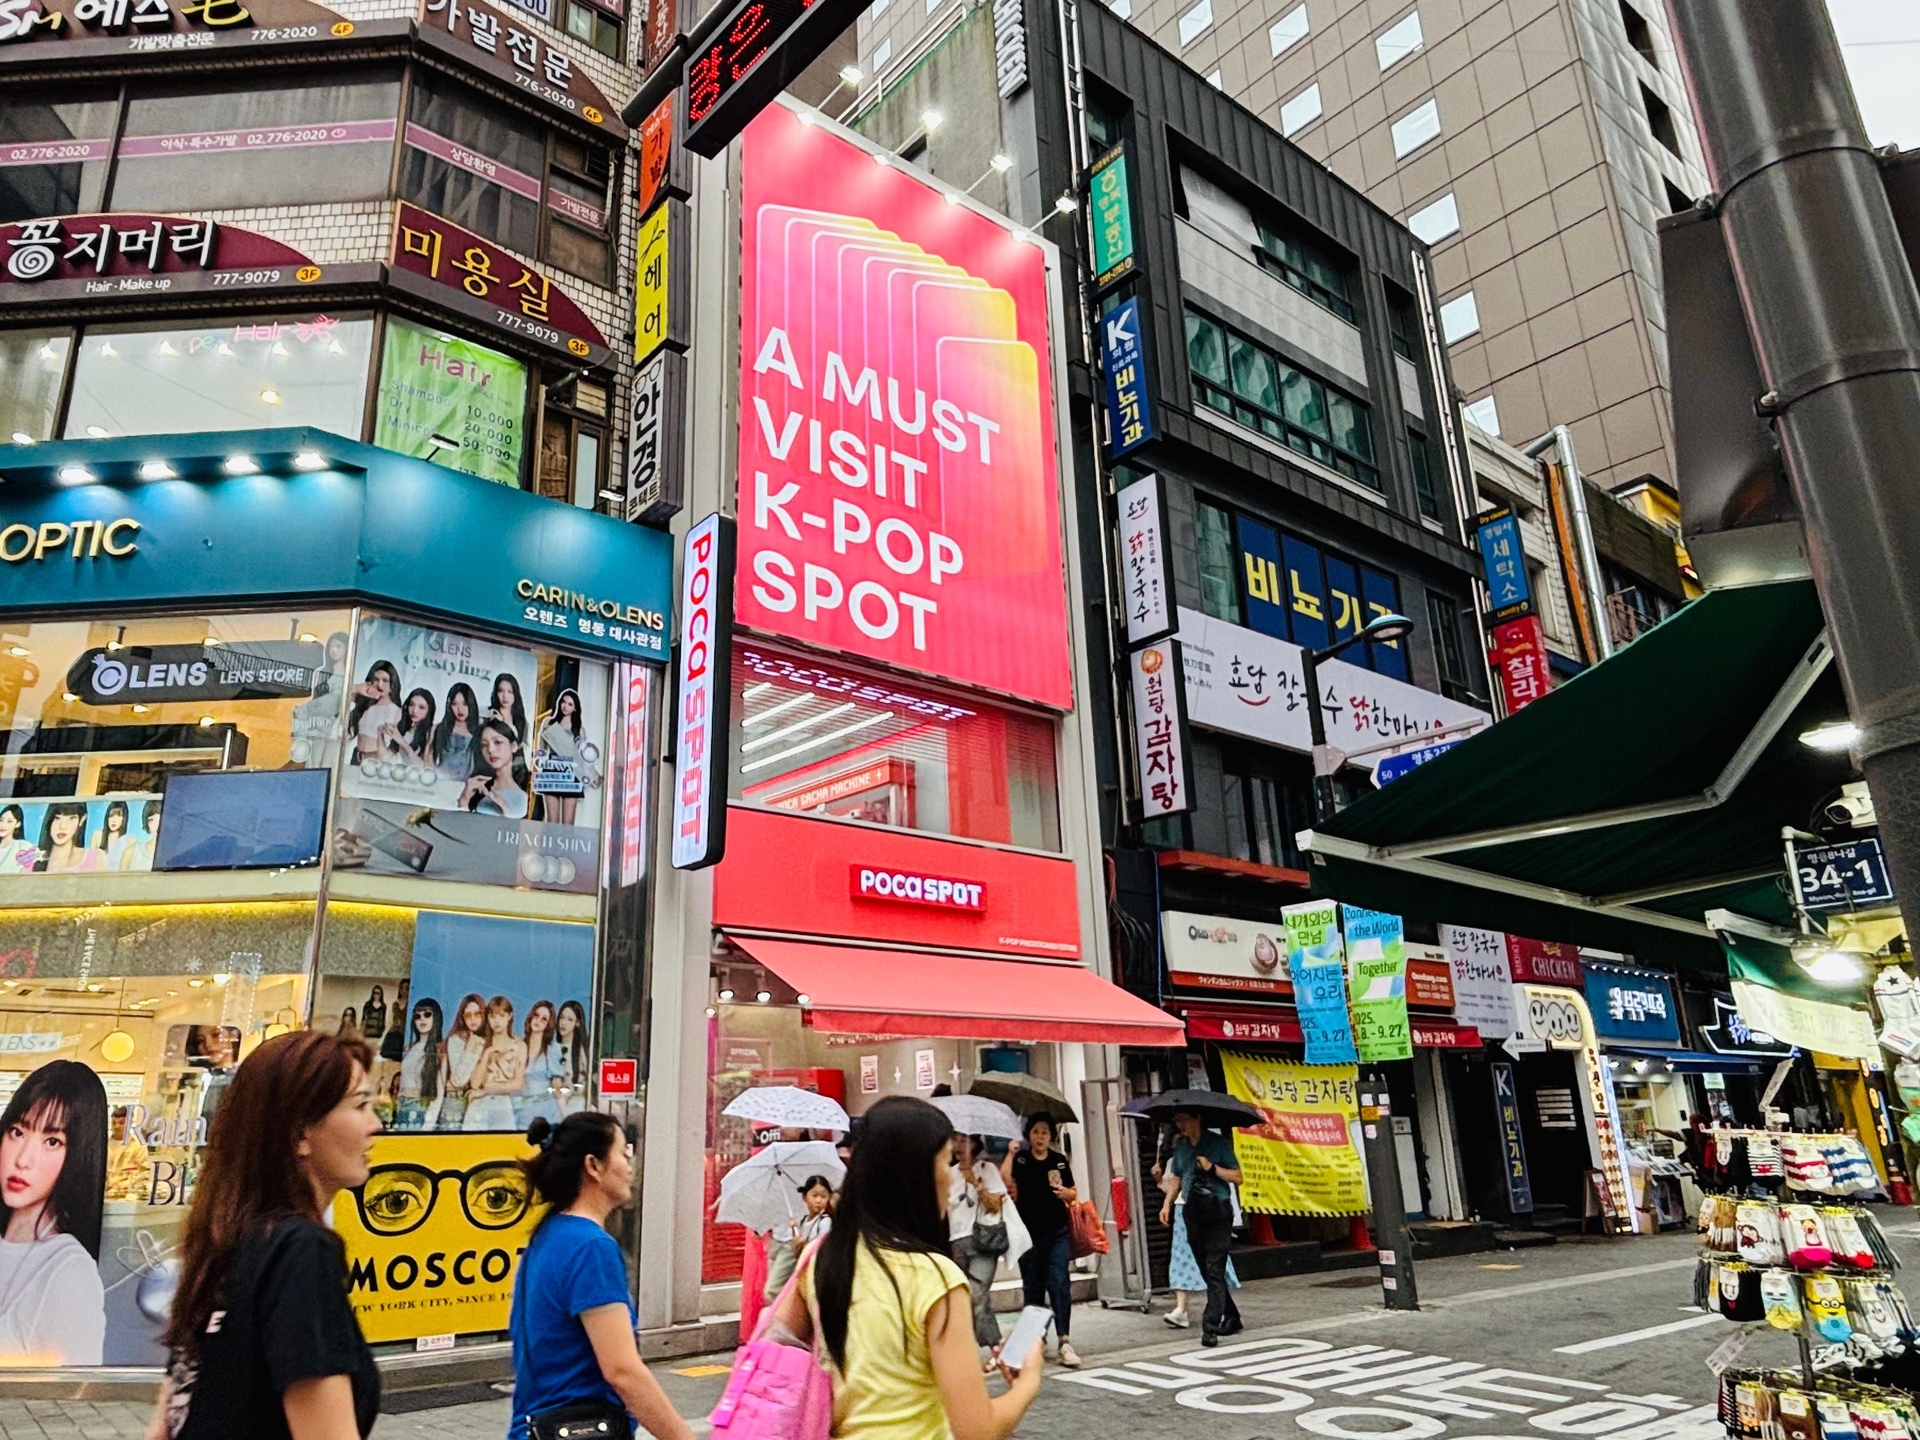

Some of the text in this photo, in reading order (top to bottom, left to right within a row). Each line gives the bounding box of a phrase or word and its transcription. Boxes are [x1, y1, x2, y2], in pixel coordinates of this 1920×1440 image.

[251, 26, 318, 41] 776-2020
[333, 24, 350, 36] 4F
[514, 71, 576, 111] 776-2020
[585, 107, 601, 123] 4F
[246, 129, 328, 146] 02.776-2020
[11, 144, 91, 161] 02.776-2020
[85, 277, 171, 294] Hair Make up
[213, 270, 281, 286] 777-9079
[299, 267, 318, 279] 3F
[401, 225, 550, 322] 미용실
[233, 320, 291, 342] Hair
[496, 309, 560, 345] 777-9079
[1106, 307, 1136, 352] K
[570, 338, 588, 354] 3F
[419, 343, 491, 388] Hair
[391, 379, 451, 407] Shampoo
[752, 326, 1001, 465] A MUST
[1115, 364, 1145, 447] 비뇨기과
[632, 381, 661, 490] 안경
[752, 394, 928, 508] VISIT
[0, 518, 141, 562] OPTIC
[754, 470, 964, 585] K-POP
[1492, 540, 1519, 602] 세탁소
[516, 578, 664, 631] CARIN&OLENS
[752, 549, 937, 652] SPOT
[523, 606, 663, 651] 오렌즈 명동 대사관점
[91, 654, 305, 696] OLENS LENS STORE
[403, 654, 493, 683] eyestyling
[1228, 655, 1267, 695] 효담
[1277, 671, 1344, 724] 칼수
[1143, 713, 1179, 810] 감자탕
[1381, 769, 1393, 780] 50
[830, 771, 871, 797] MACHINE
[1799, 859, 1874, 893] 34-1
[1297, 929, 1323, 947] 만남
[1354, 919, 1399, 937] the World
[1357, 961, 1398, 978] Together
[1531, 956, 1577, 980] CHICKEN
[1314, 984, 1343, 1000] 우리
[606, 1072, 630, 1084] 에스원
[1269, 1077, 1354, 1105] 원당 감자탕
[1494, 1068, 1512, 1098] K
[1503, 1105, 1524, 1179] 비뇨기과
[351, 1303, 375, 1314] EW
[380, 1300, 416, 1312] YORK
[456, 1293, 496, 1305] SINCE
